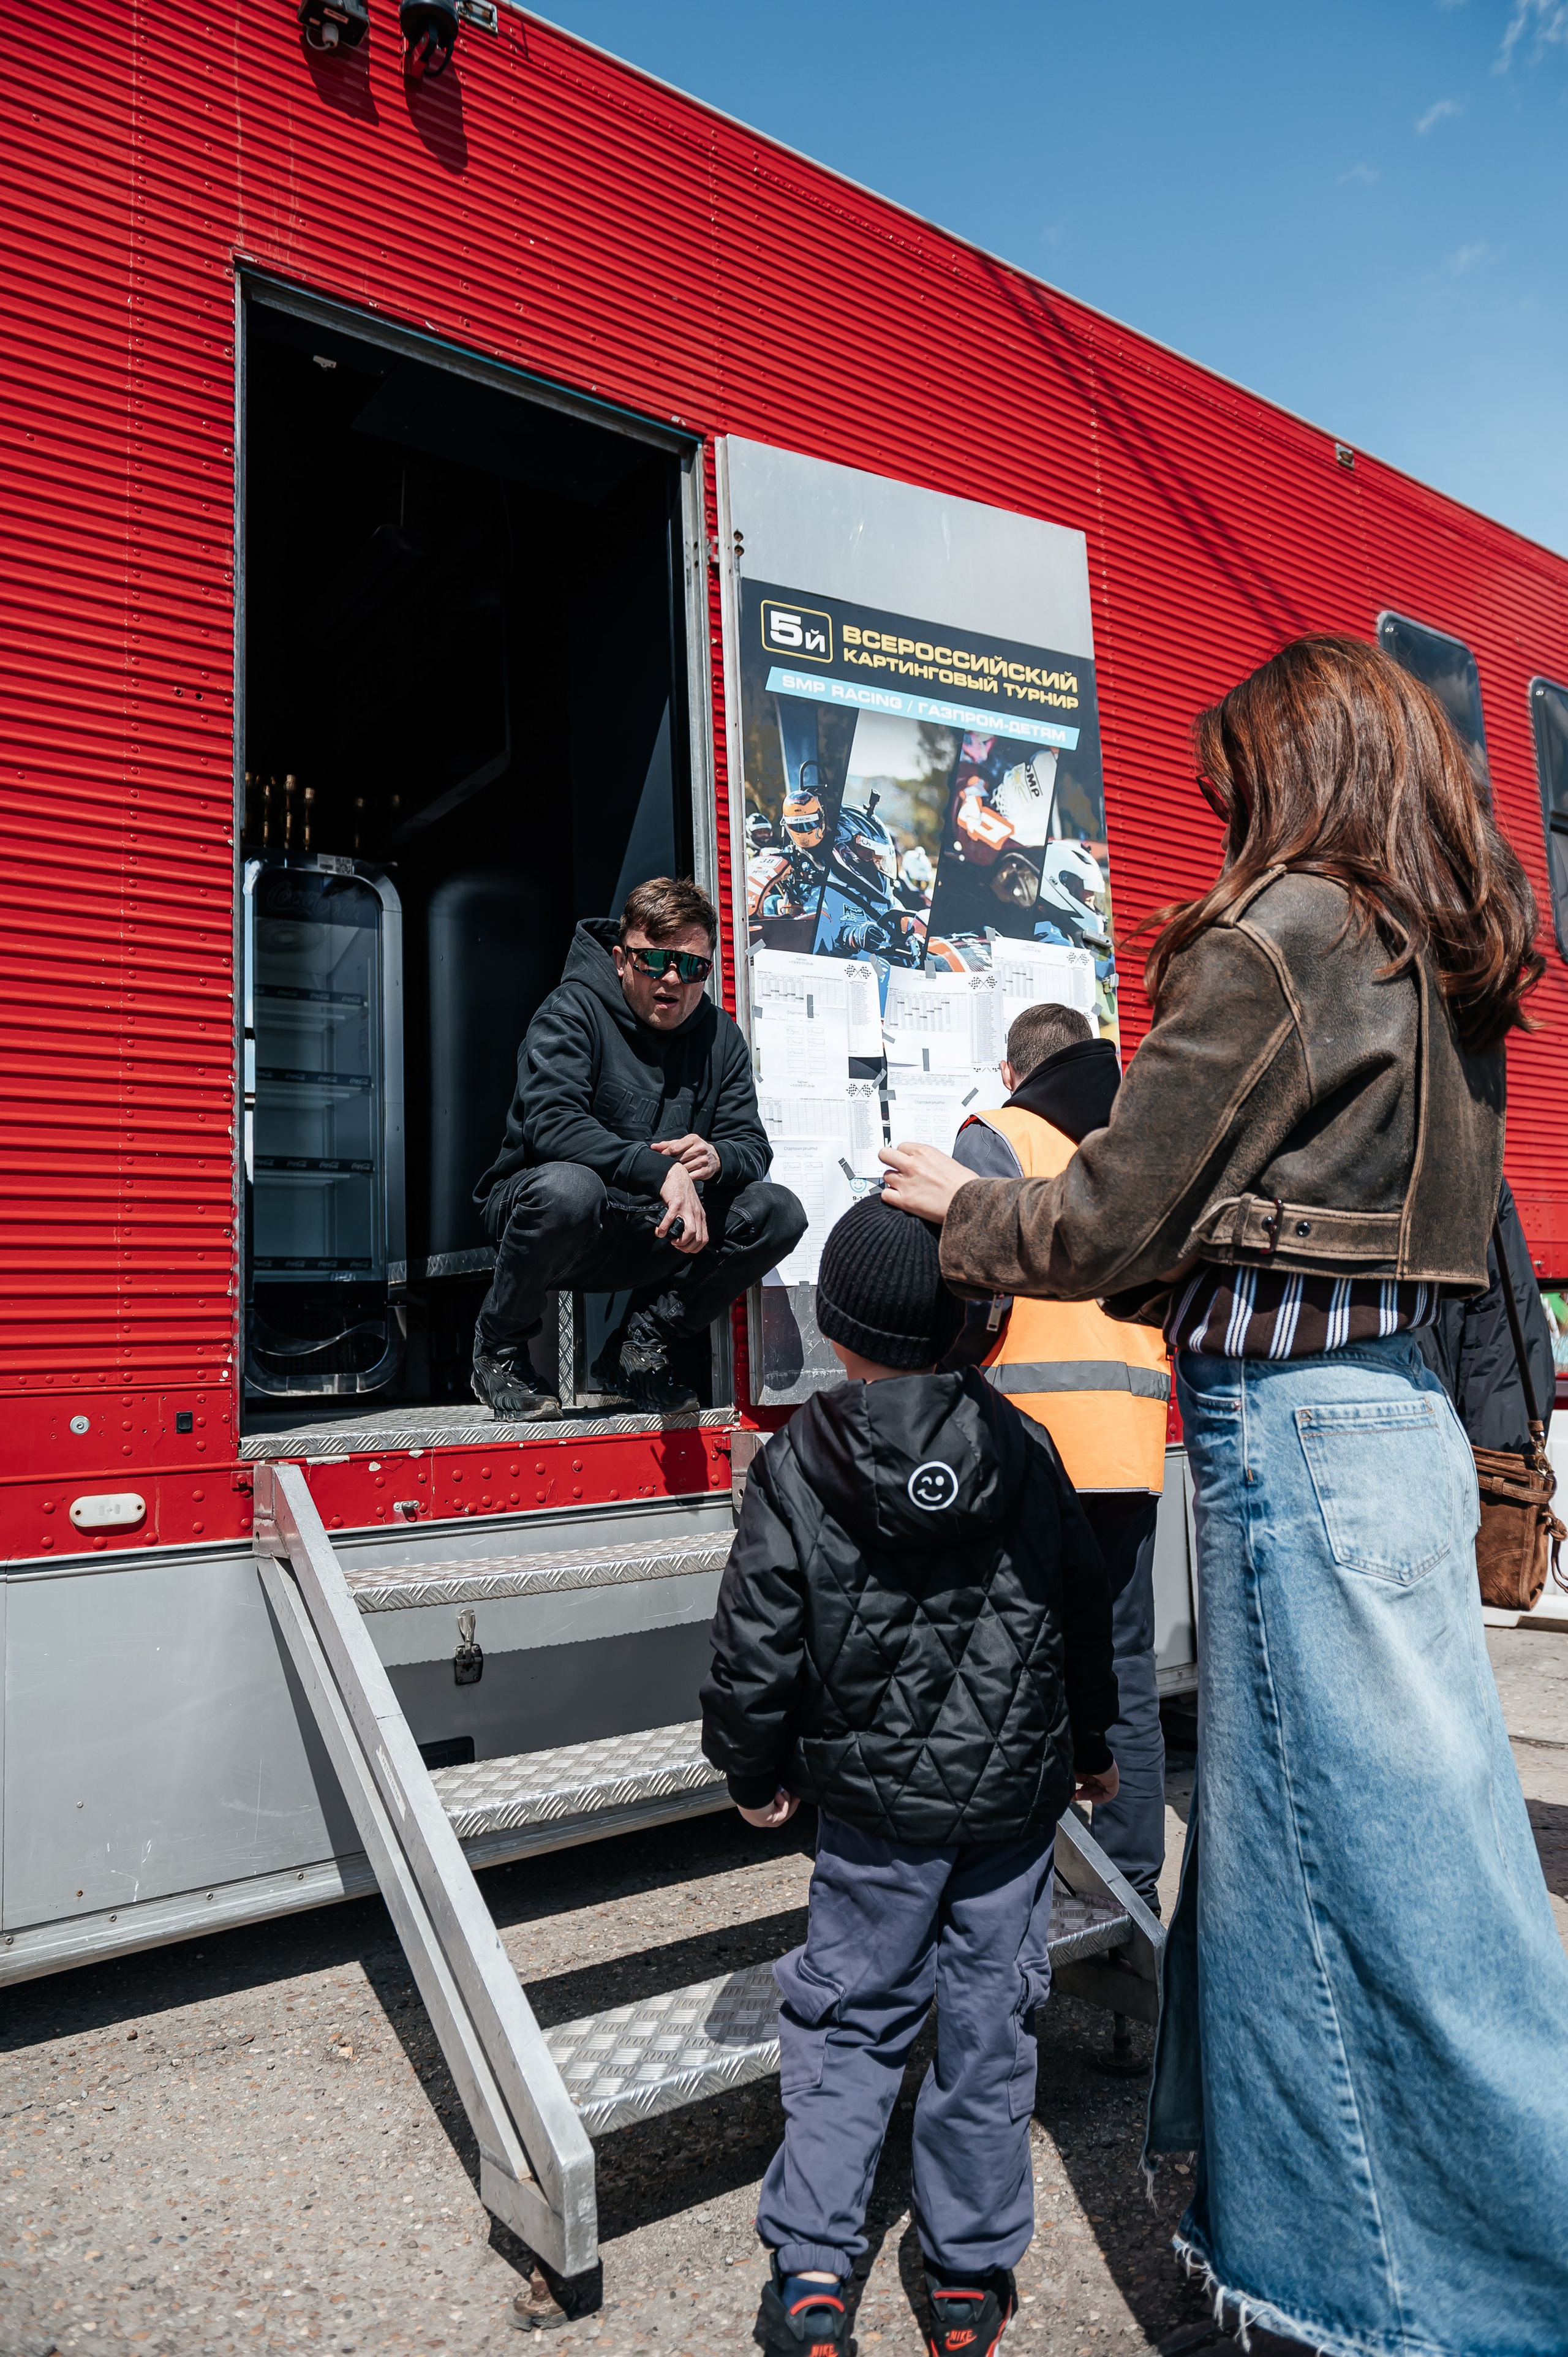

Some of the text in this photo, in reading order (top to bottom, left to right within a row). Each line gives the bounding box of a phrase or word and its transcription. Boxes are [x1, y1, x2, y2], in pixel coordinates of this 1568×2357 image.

[769, 610, 826, 653] 5й
[842, 624, 1079, 693] ВСЕРОССИЙСКИЙ
[843, 647, 1079, 710] КАРТИНГОВЫЙ ТУРНИР
[782, 674, 914, 712] SMP RACING /
[918, 701, 1067, 742] ГАЗПРОМ-ДЕТЯМ
[811, 2344, 835, 2356] NIKE
[949, 2329, 974, 2342] NIKE
